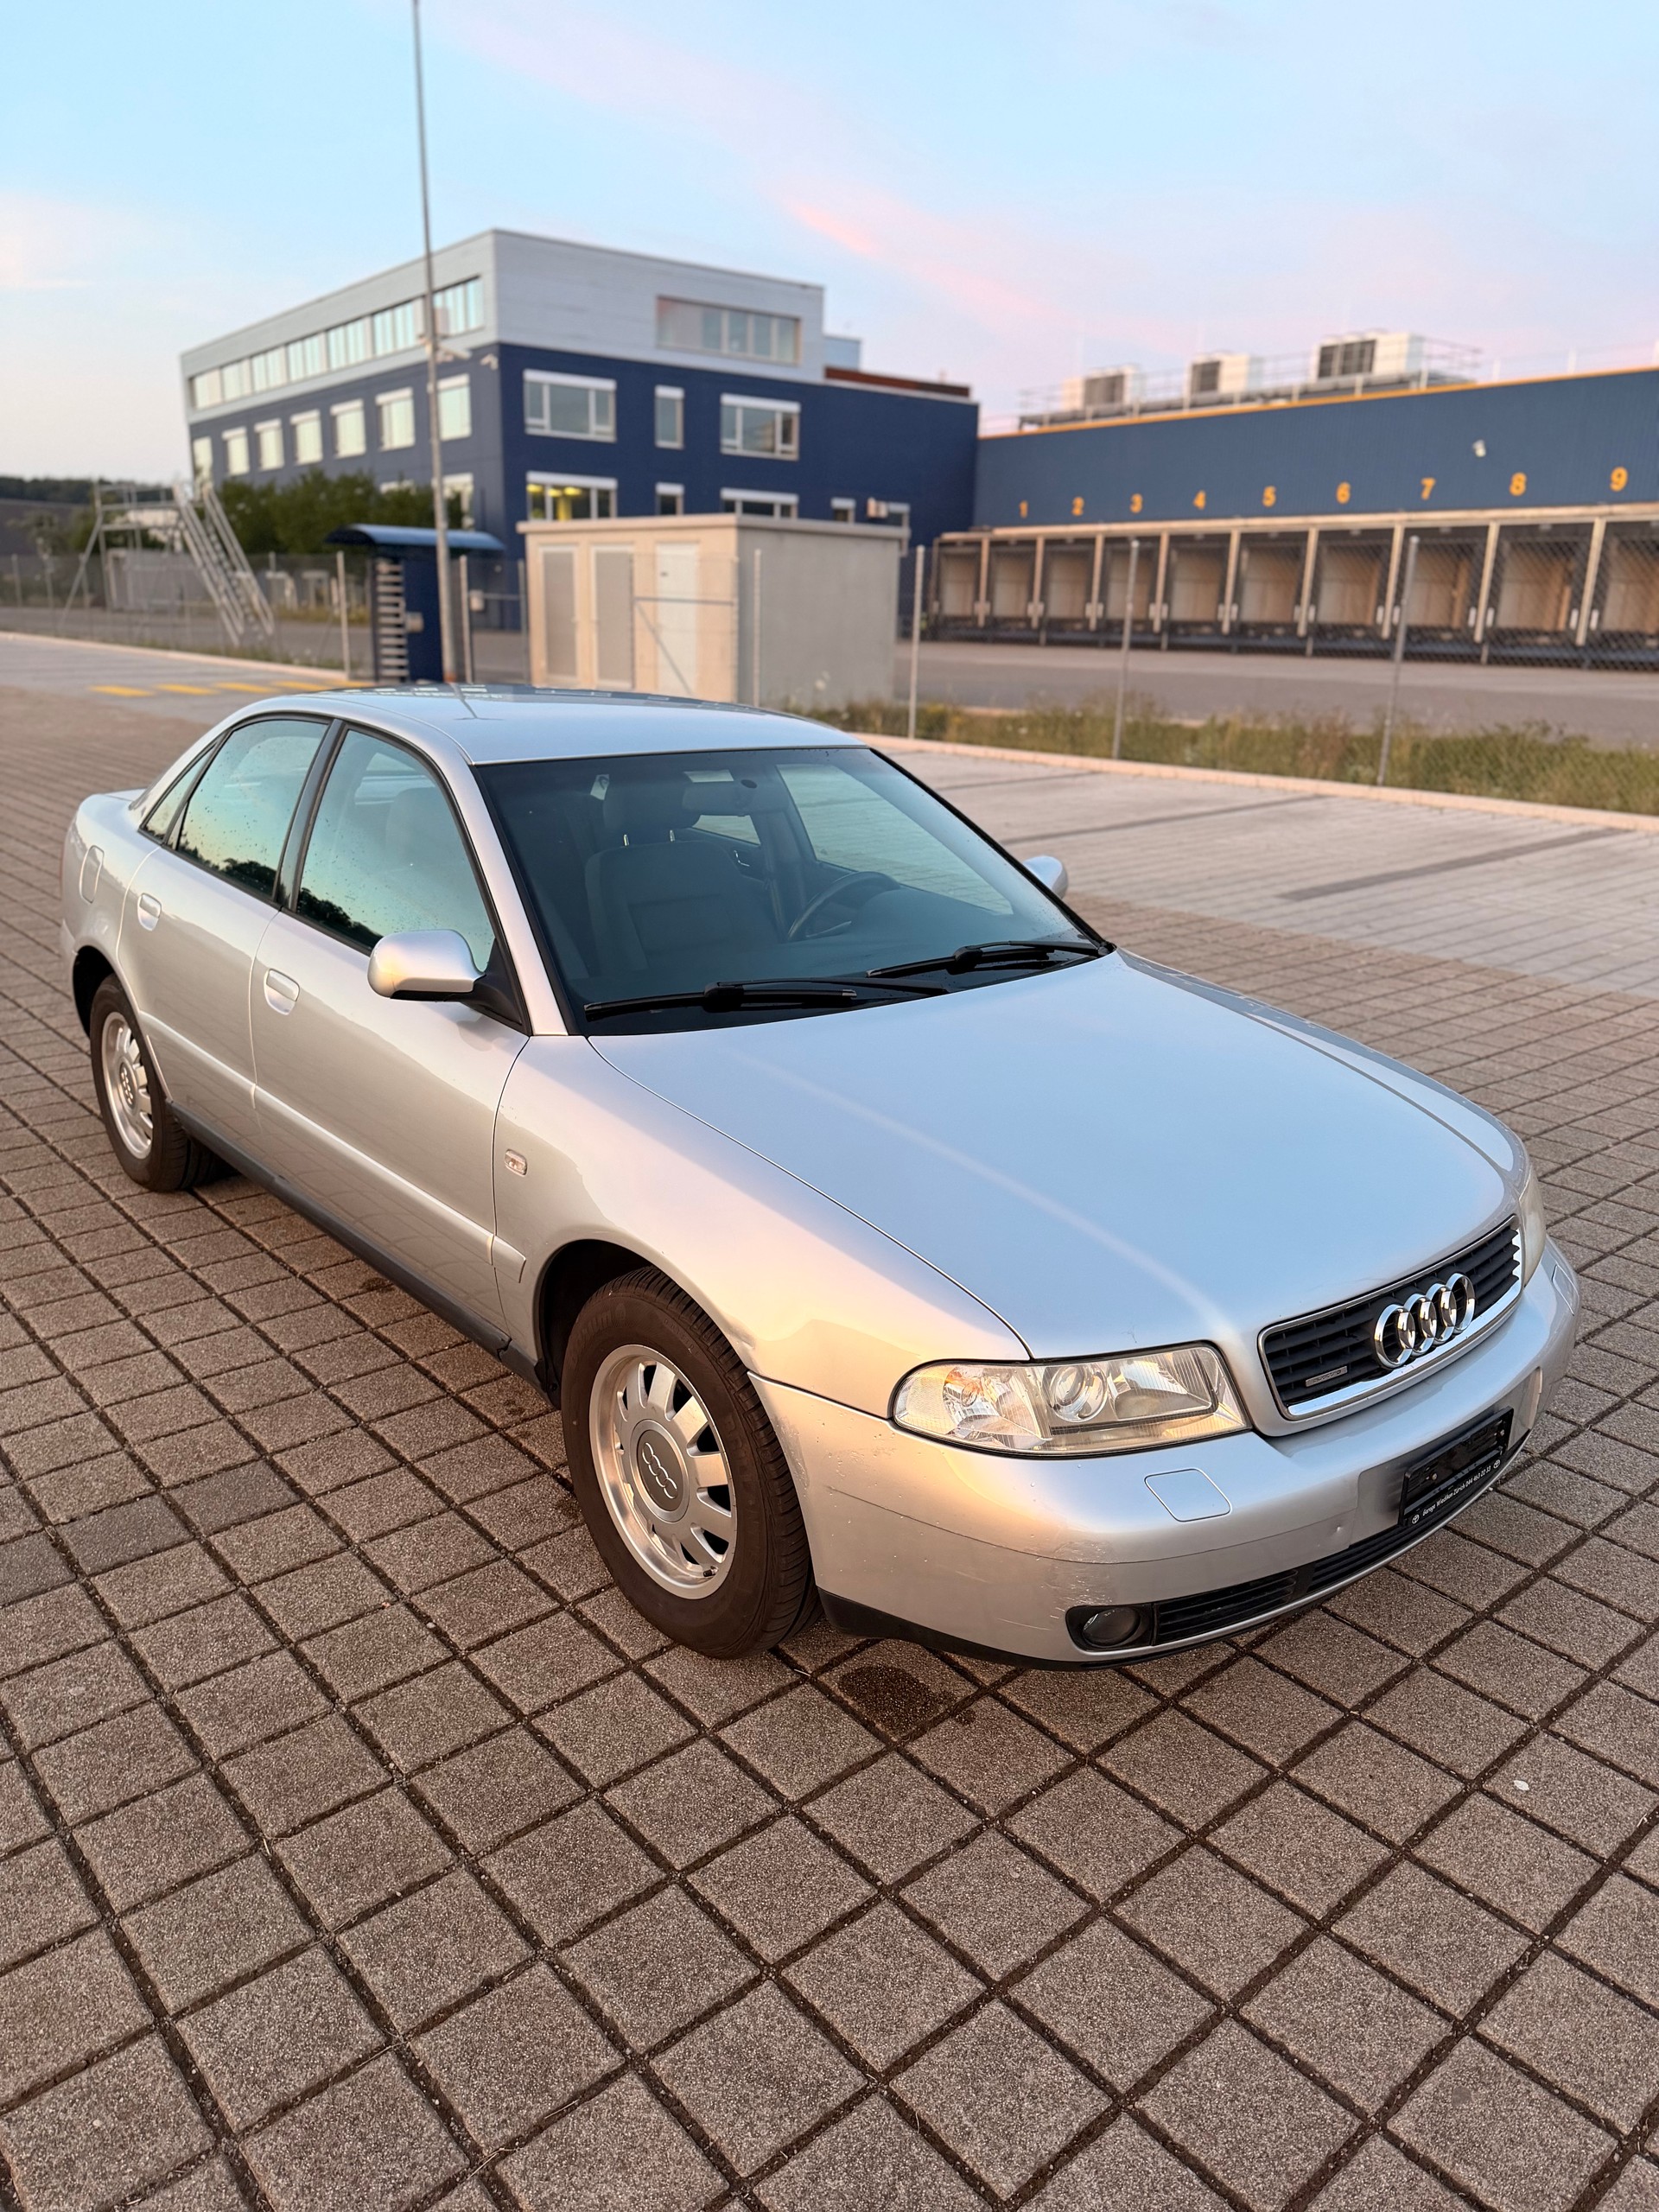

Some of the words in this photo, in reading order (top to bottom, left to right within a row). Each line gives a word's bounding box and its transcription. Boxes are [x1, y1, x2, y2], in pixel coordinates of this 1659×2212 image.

[1019, 501, 1028, 518] 1
[1071, 497, 1084, 517] 2
[1129, 493, 1143, 514] 3
[1192, 491, 1206, 510] 4
[1262, 486, 1276, 508] 5
[1336, 482, 1351, 505] 6
[1420, 477, 1436, 500] 7
[1509, 472, 1527, 497] 8
[1610, 467, 1629, 493] 9
[1422, 1503, 1436, 1516] Garage
